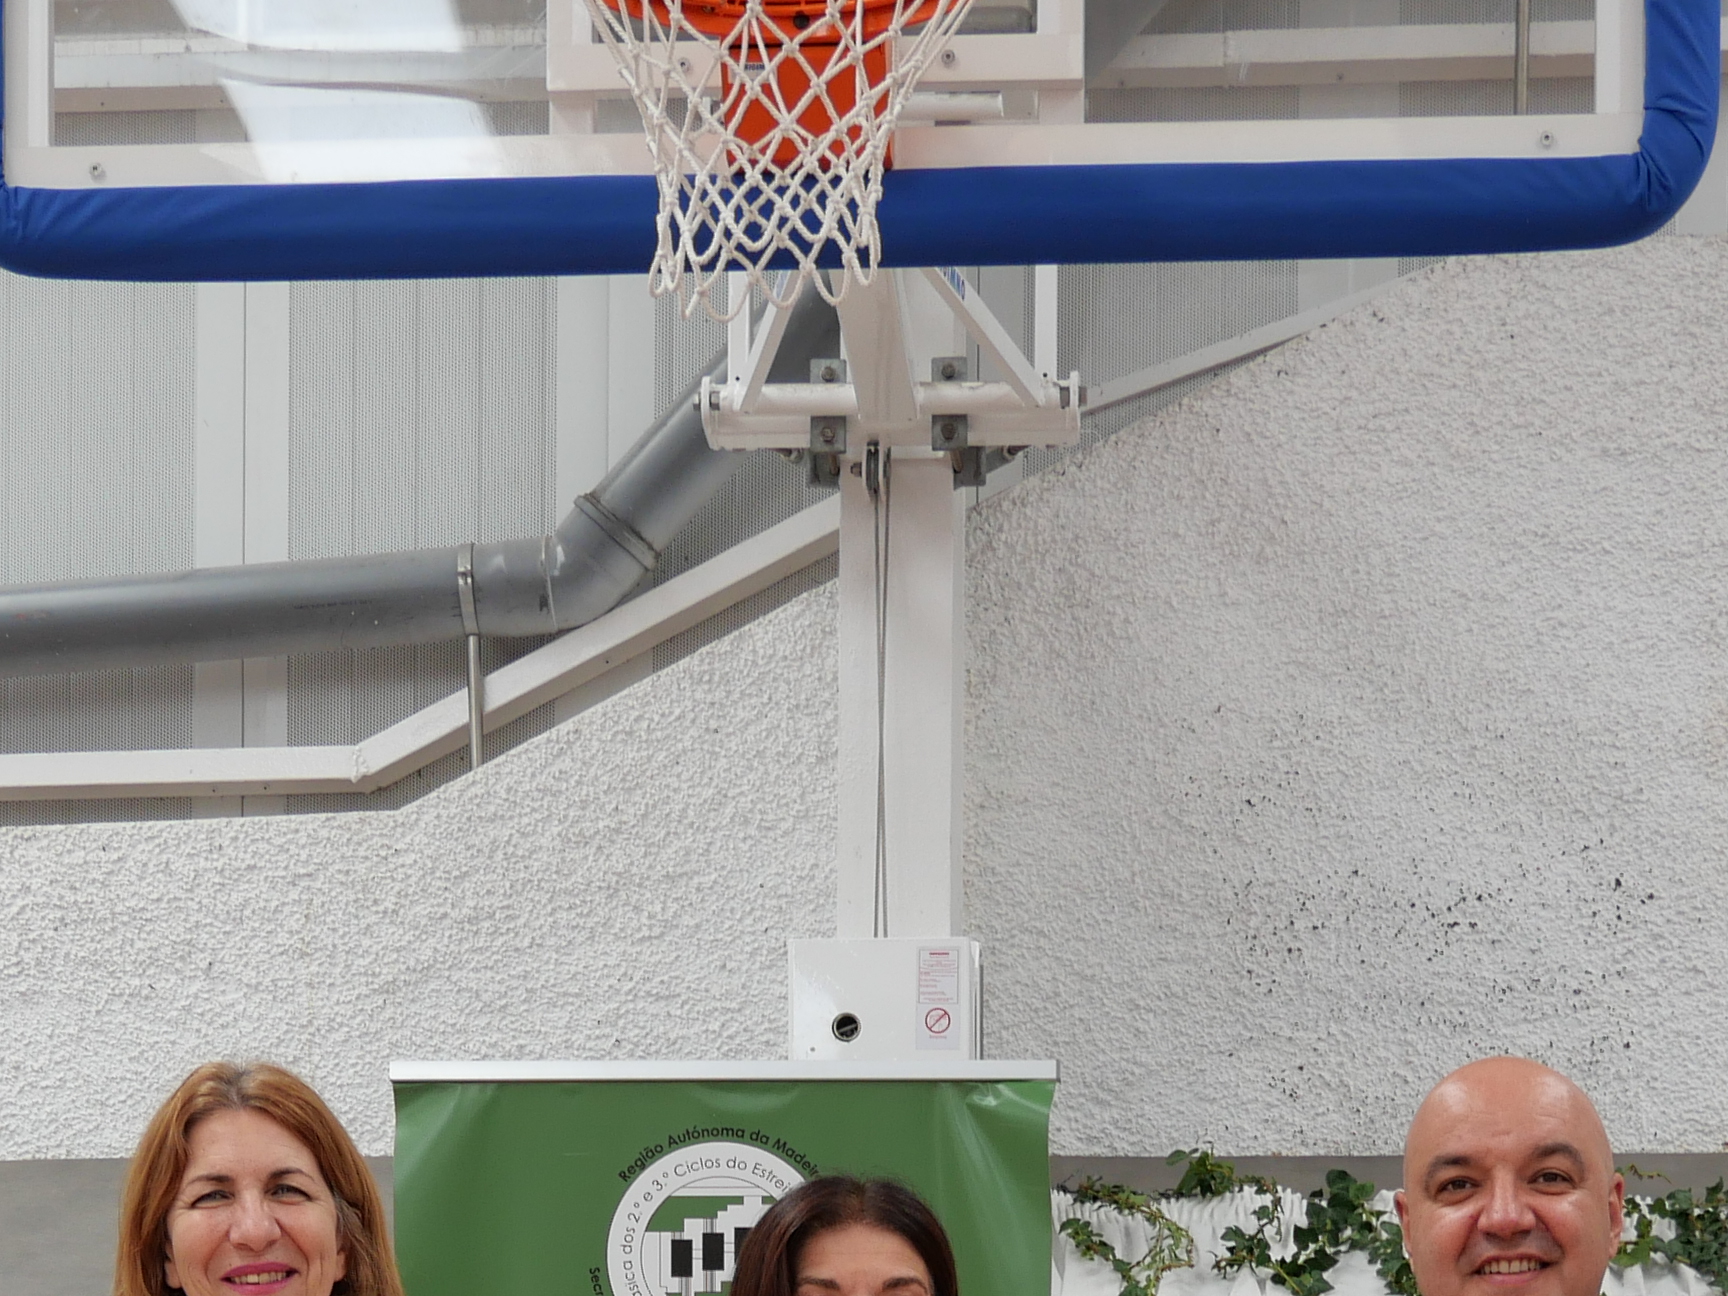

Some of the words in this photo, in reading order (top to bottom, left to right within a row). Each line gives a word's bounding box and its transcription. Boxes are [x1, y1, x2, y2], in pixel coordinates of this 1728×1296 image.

[618, 1142, 664, 1182] Região
[667, 1125, 745, 1148] Autónoma
[749, 1129, 770, 1145] da
[772, 1138, 821, 1179] Madeir
[621, 1227, 636, 1255] dos
[643, 1191, 653, 1203] e
[674, 1157, 721, 1177] Ciclos
[726, 1156, 747, 1171] do
